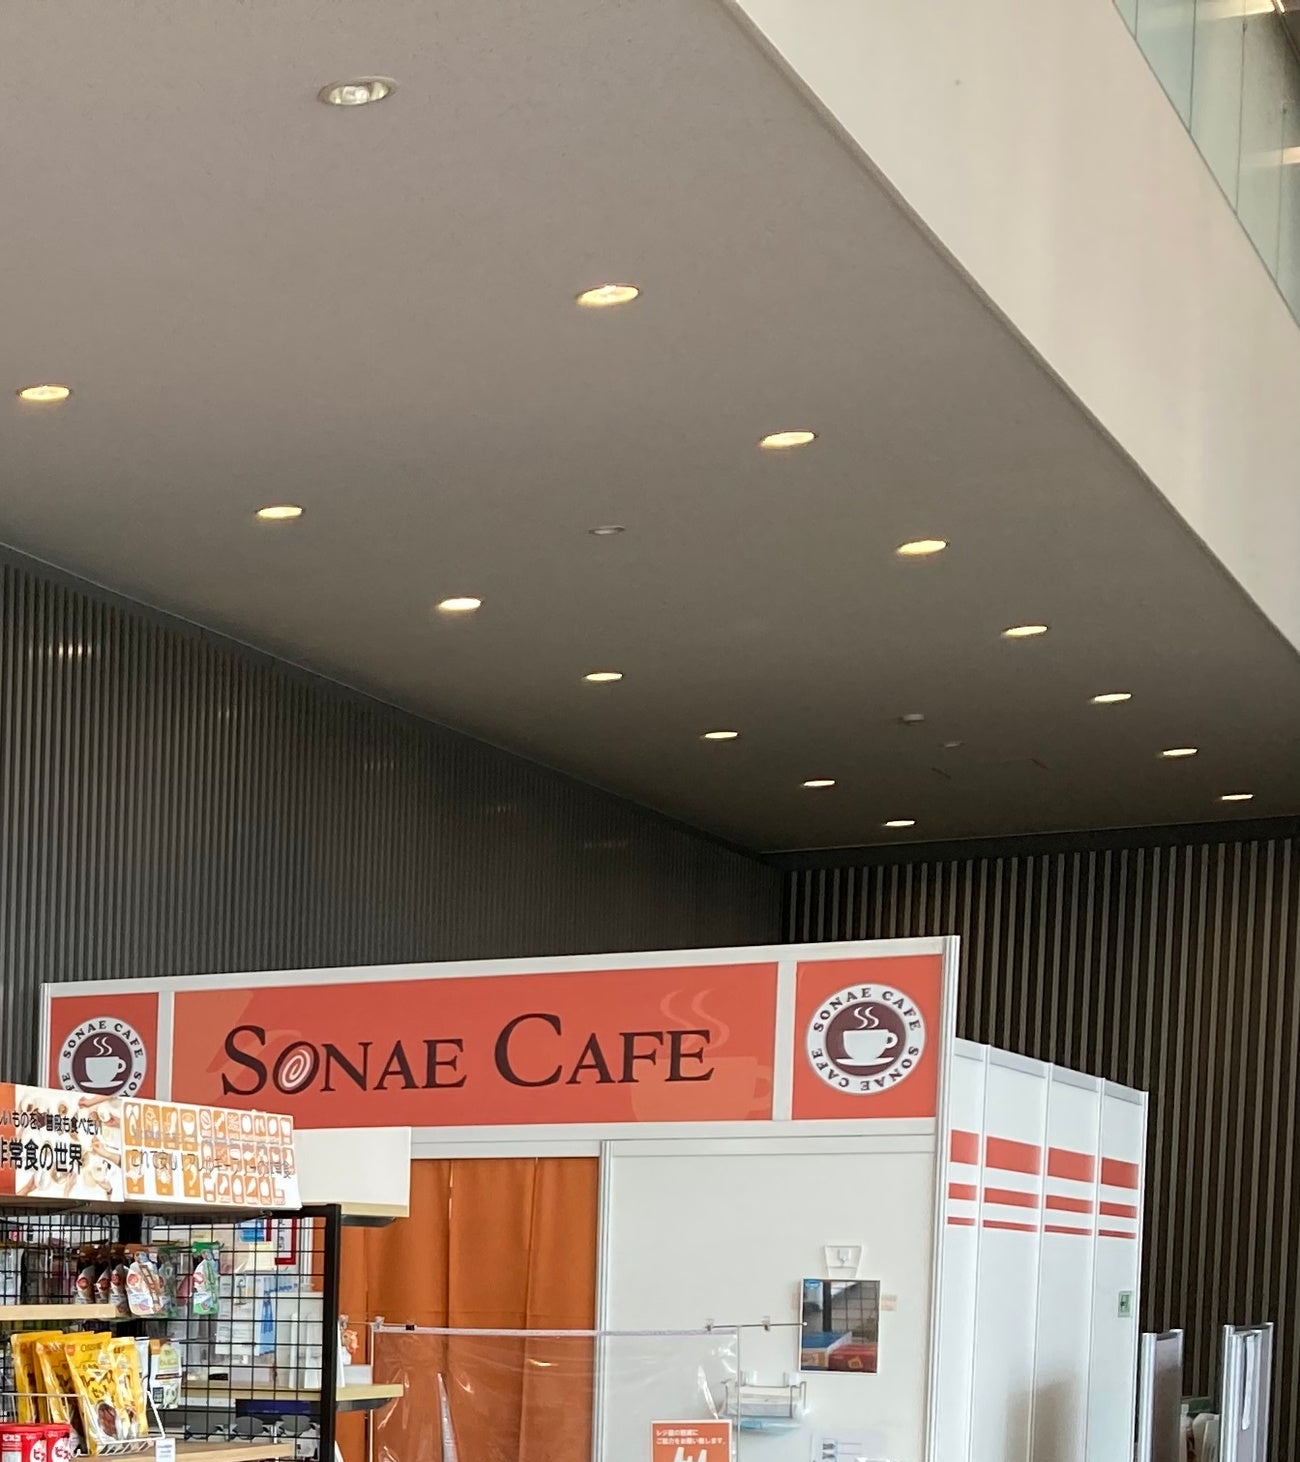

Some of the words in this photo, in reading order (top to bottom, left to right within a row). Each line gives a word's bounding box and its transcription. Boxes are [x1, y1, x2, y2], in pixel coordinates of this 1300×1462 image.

[813, 987, 873, 1033] SONAE
[881, 990, 922, 1031] CAFE
[63, 1019, 107, 1060] SONAE
[113, 1022, 144, 1058] CAFE
